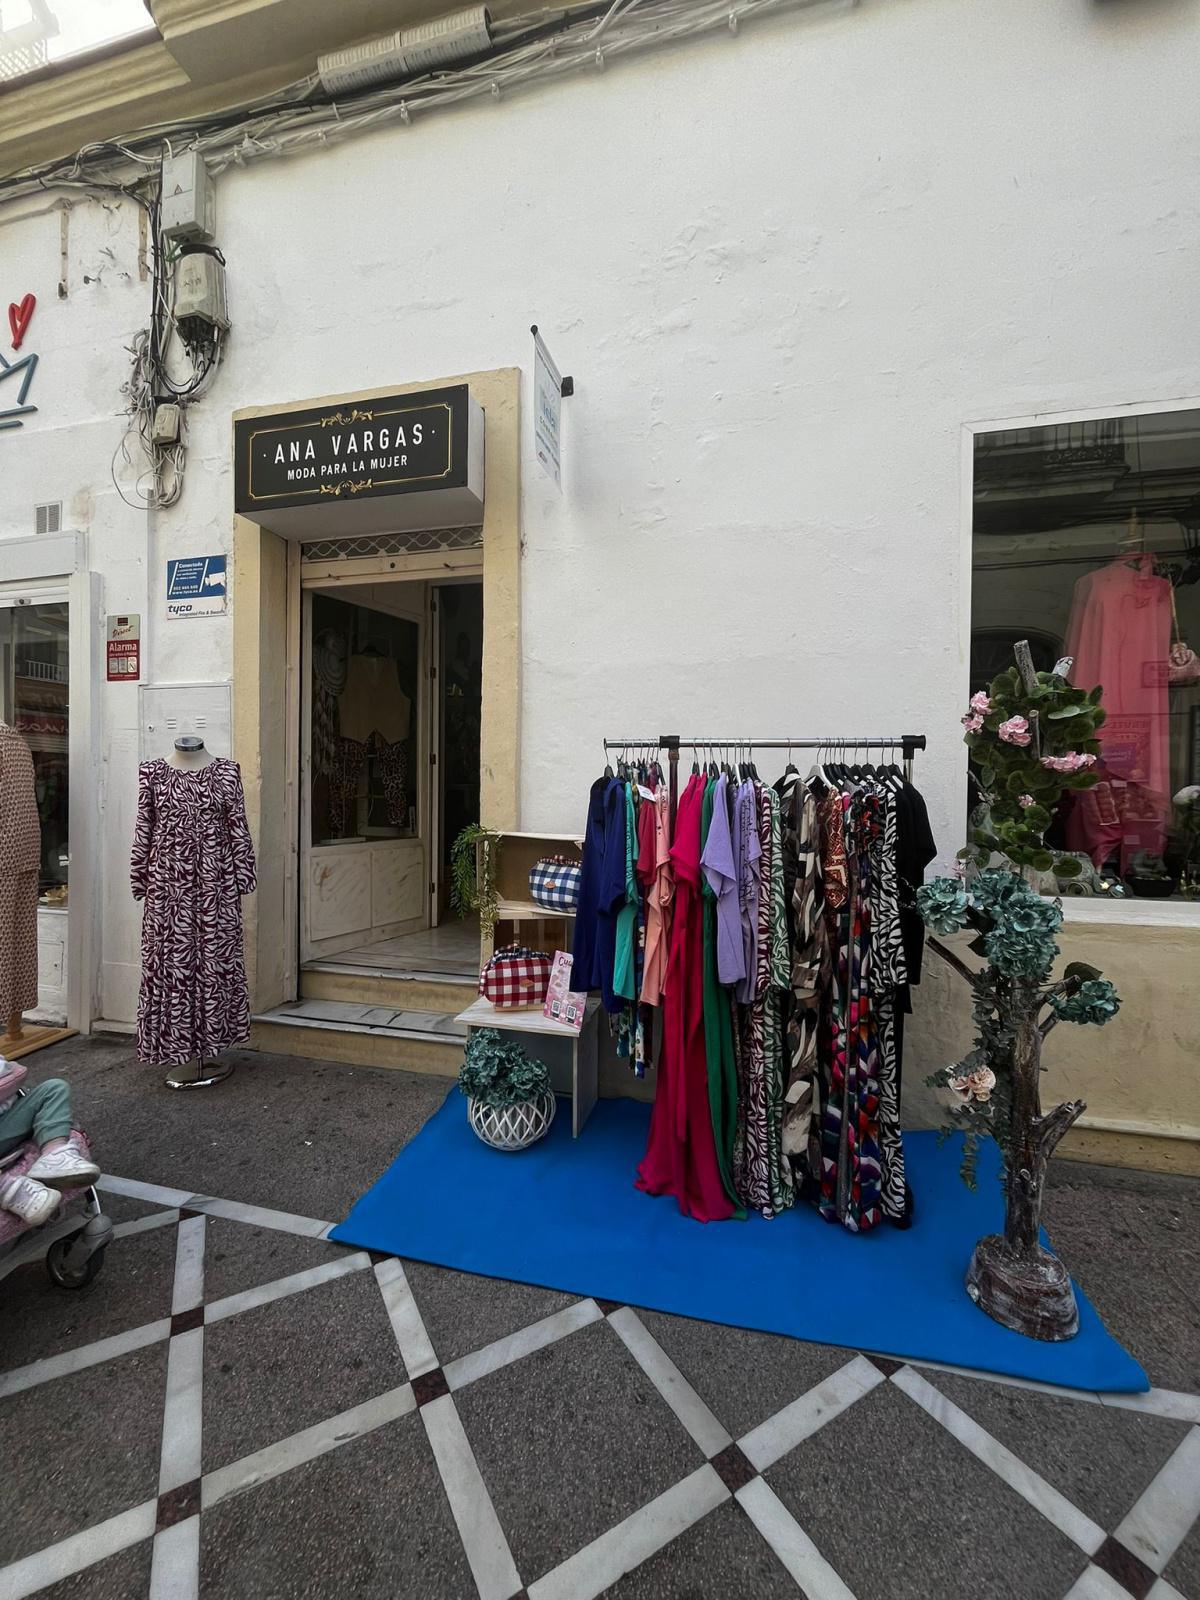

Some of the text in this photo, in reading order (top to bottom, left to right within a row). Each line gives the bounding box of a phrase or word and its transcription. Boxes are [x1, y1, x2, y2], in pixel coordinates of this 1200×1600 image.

[274, 423, 423, 464] ANA VARGAS
[287, 454, 408, 481] MODA PARA LA MUJER
[168, 604, 192, 614] tyco
[109, 643, 137, 652] Alarma
